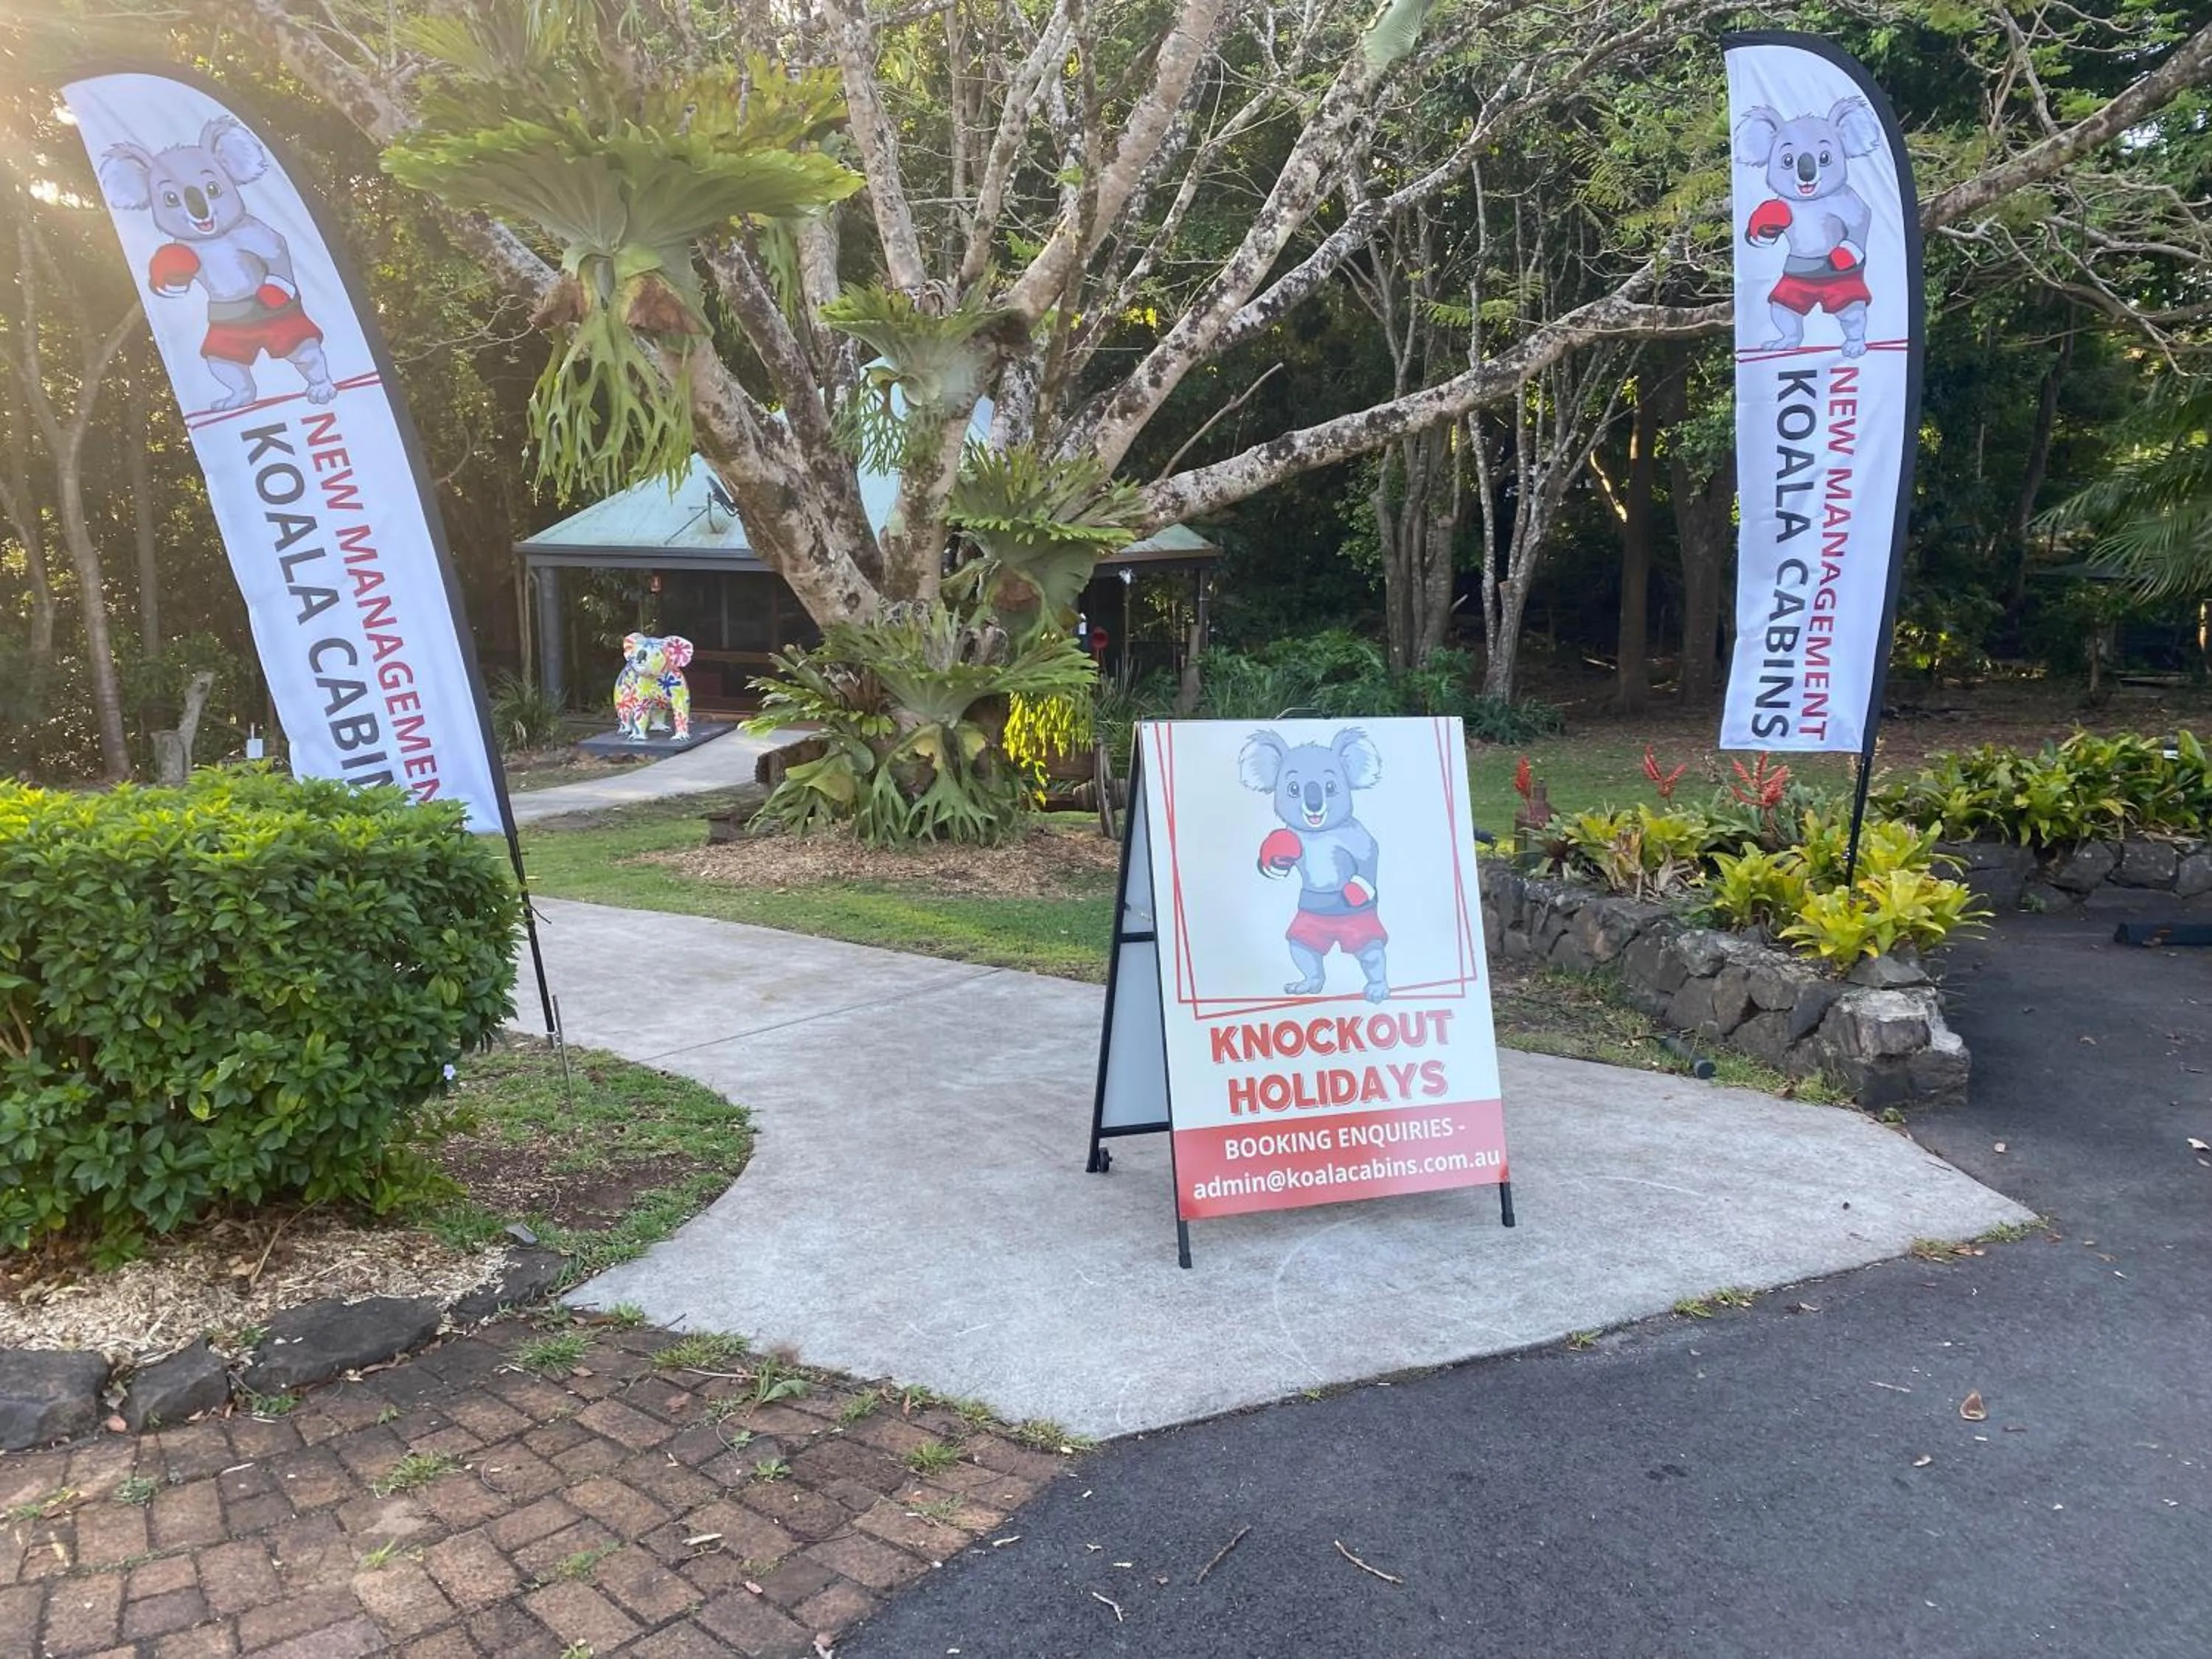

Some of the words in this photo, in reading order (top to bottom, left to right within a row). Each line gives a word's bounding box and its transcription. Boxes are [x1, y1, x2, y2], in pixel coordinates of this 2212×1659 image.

[1775, 369, 1818, 544] KOALA
[1827, 366, 1860, 456] NEW
[240, 422, 340, 626] KOALA
[308, 637, 395, 788] CABI
[300, 411, 364, 511] NEW
[335, 524, 442, 804] MANAGEMEN
[1750, 558, 1809, 738] CABINS
[1799, 467, 1853, 741] MANAGEMENT
[1210, 1009, 1453, 1064] KNOCKOUT
[1228, 1060, 1449, 1116] HOLIDAYS
[1193, 1147, 1500, 1200] admin@koalacabins.com.au
[1225, 1129, 1332, 1161] BOOKING
[1338, 1117, 1453, 1149] ENQUIRIES
